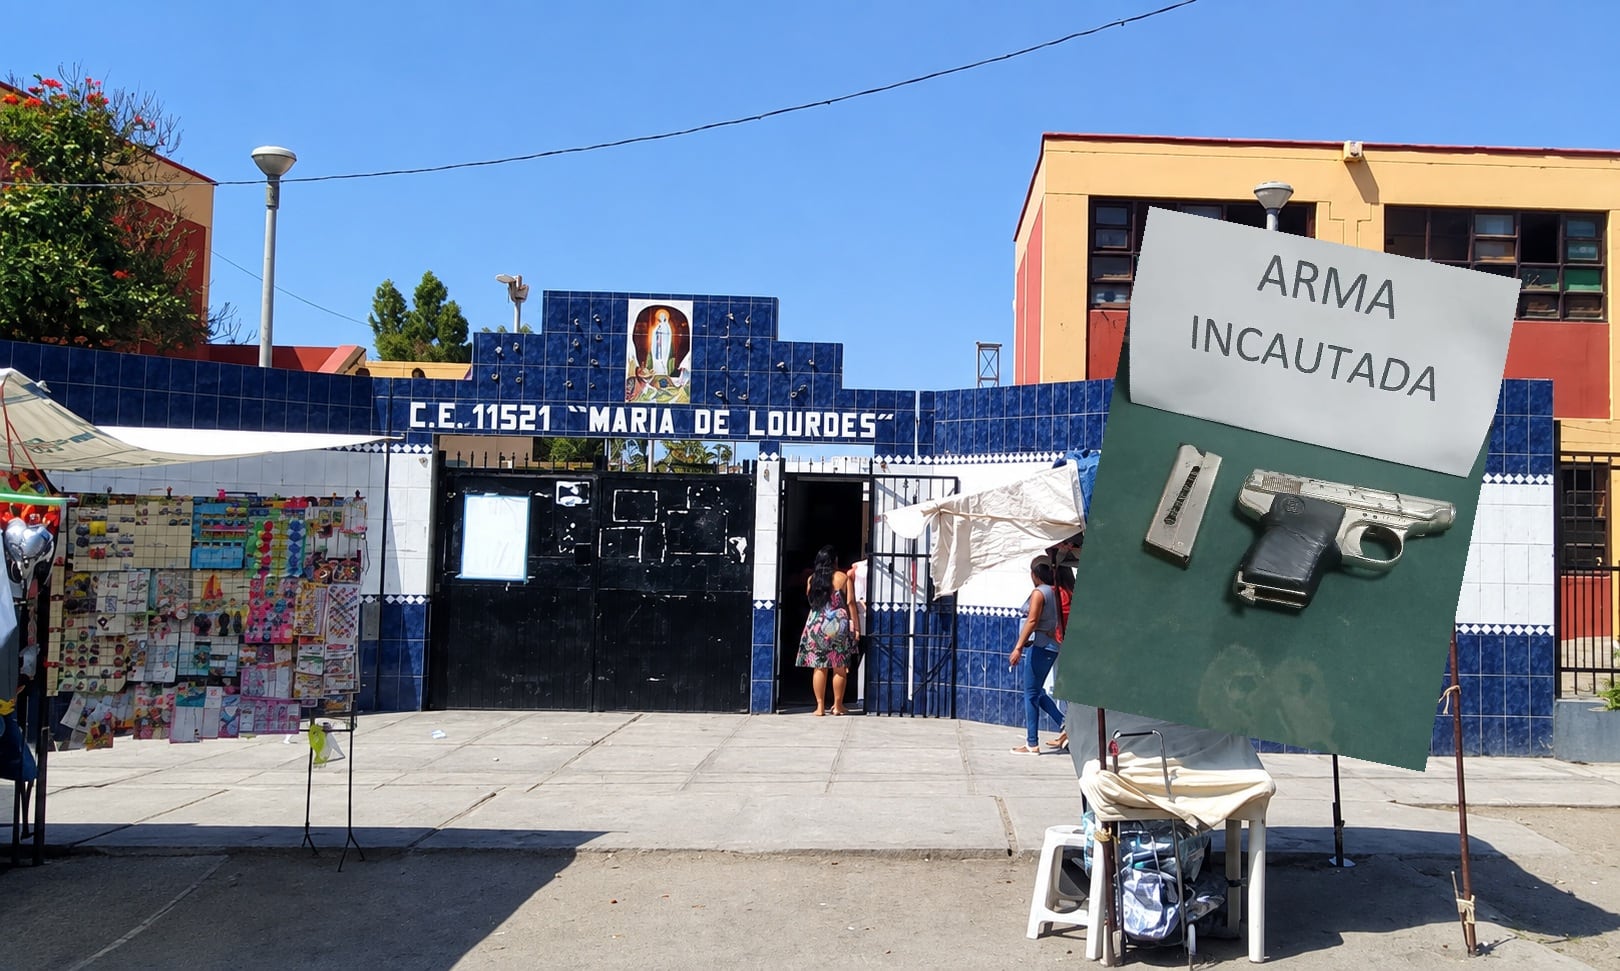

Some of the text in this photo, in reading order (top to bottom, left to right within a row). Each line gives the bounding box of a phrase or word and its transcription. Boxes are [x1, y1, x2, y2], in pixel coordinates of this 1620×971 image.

[1257, 254, 1395, 320] ARMA
[1191, 315, 1436, 402] INCAUTADA
[410, 401, 463, 431] C.E.
[472, 403, 551, 432] 11521
[694, 408, 730, 435] DE
